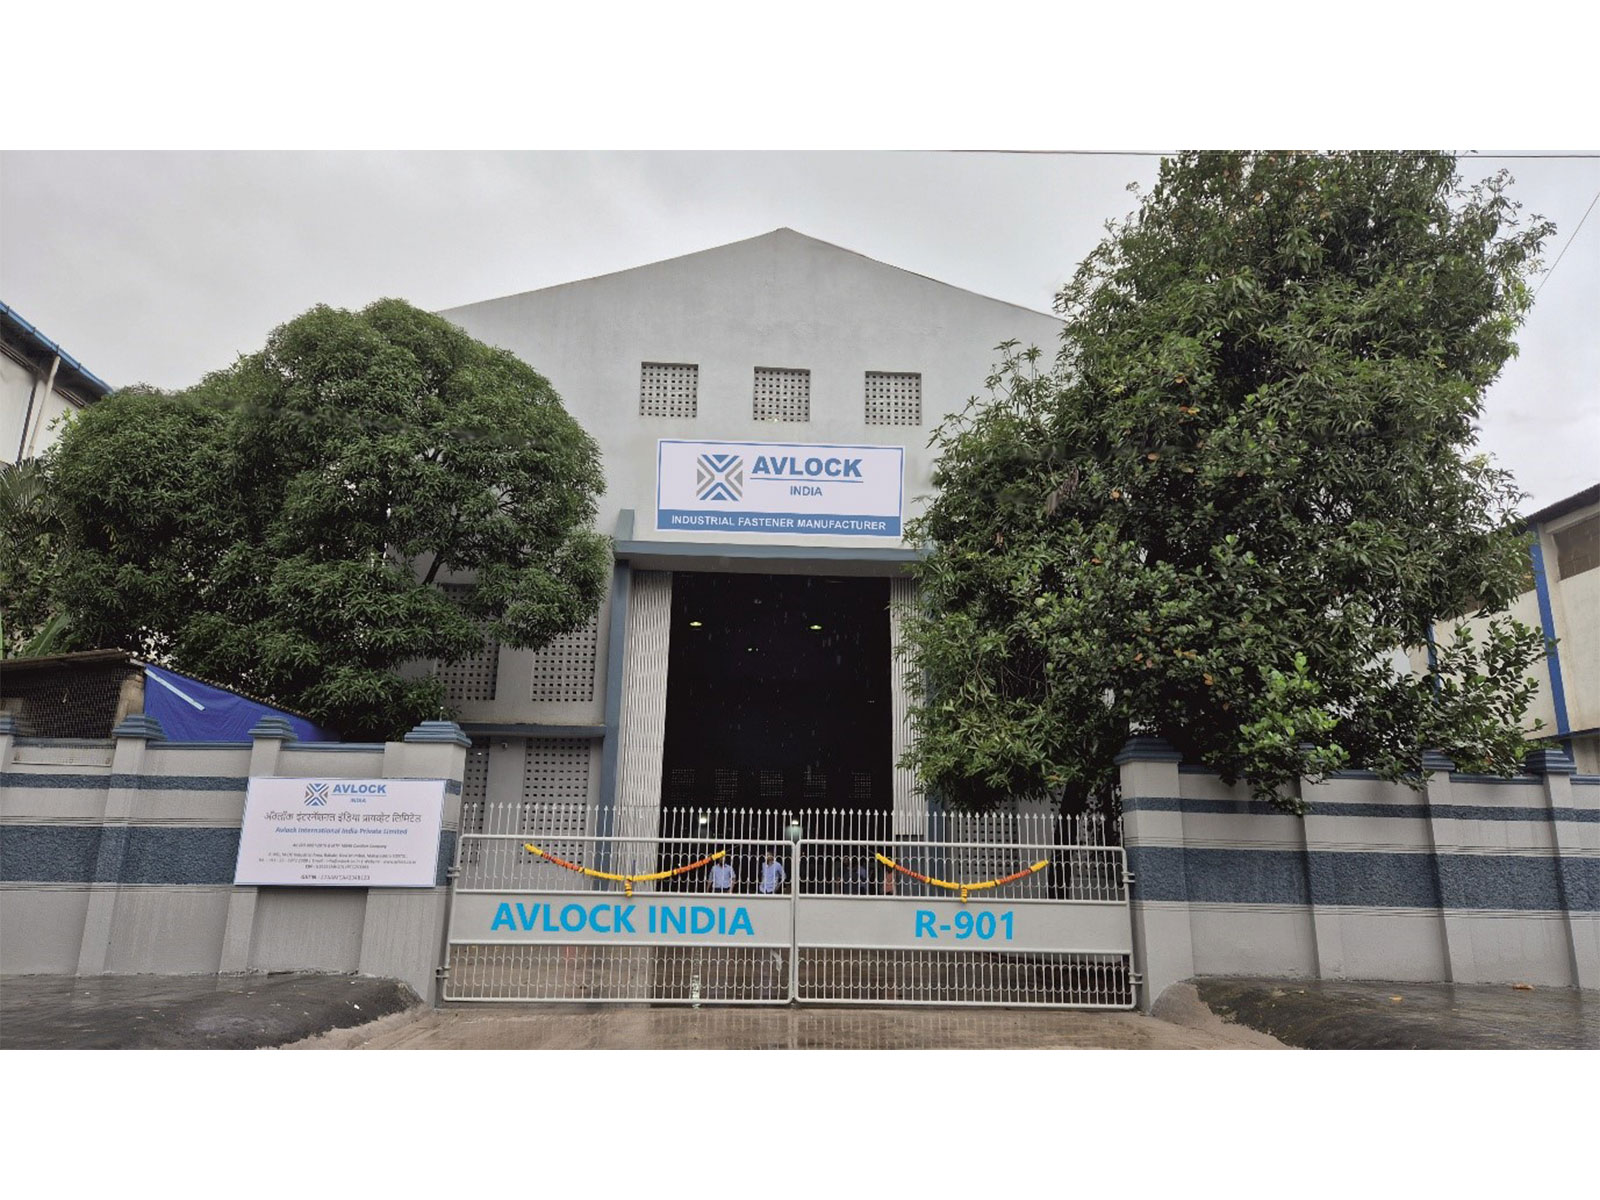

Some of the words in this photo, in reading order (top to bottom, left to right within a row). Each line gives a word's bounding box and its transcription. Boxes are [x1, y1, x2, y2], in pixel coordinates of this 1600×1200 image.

[751, 455, 864, 478] AVLOCK
[790, 485, 823, 497] INDIA
[671, 515, 735, 527] INDUSTRIAL
[738, 517, 794, 528] FASTENER
[797, 518, 887, 531] MANUFACTURER
[332, 784, 387, 794] AVLOCK
[275, 826, 297, 834] Avlock
[298, 827, 340, 835] International
[341, 827, 358, 835] India
[383, 828, 408, 836] Limited
[490, 902, 636, 934] AVLOCK
[647, 906, 755, 936] INDIA
[914, 909, 1015, 941] R-901
